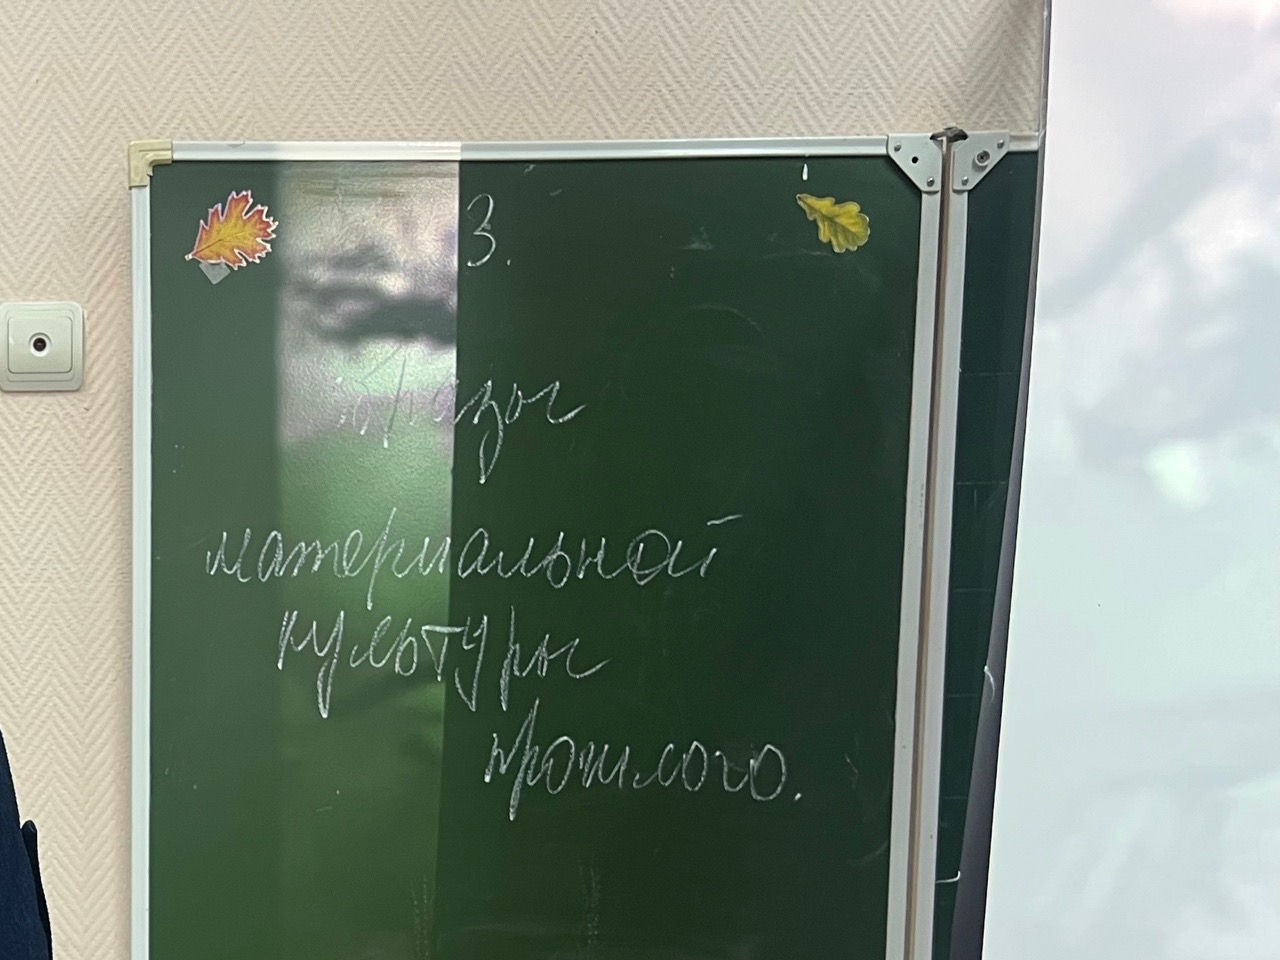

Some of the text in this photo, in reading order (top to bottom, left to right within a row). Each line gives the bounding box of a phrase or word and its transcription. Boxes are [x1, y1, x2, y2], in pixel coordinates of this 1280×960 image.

[466, 192, 512, 267] 3.
[205, 506, 743, 610] материальной
[276, 605, 609, 718] культуры
